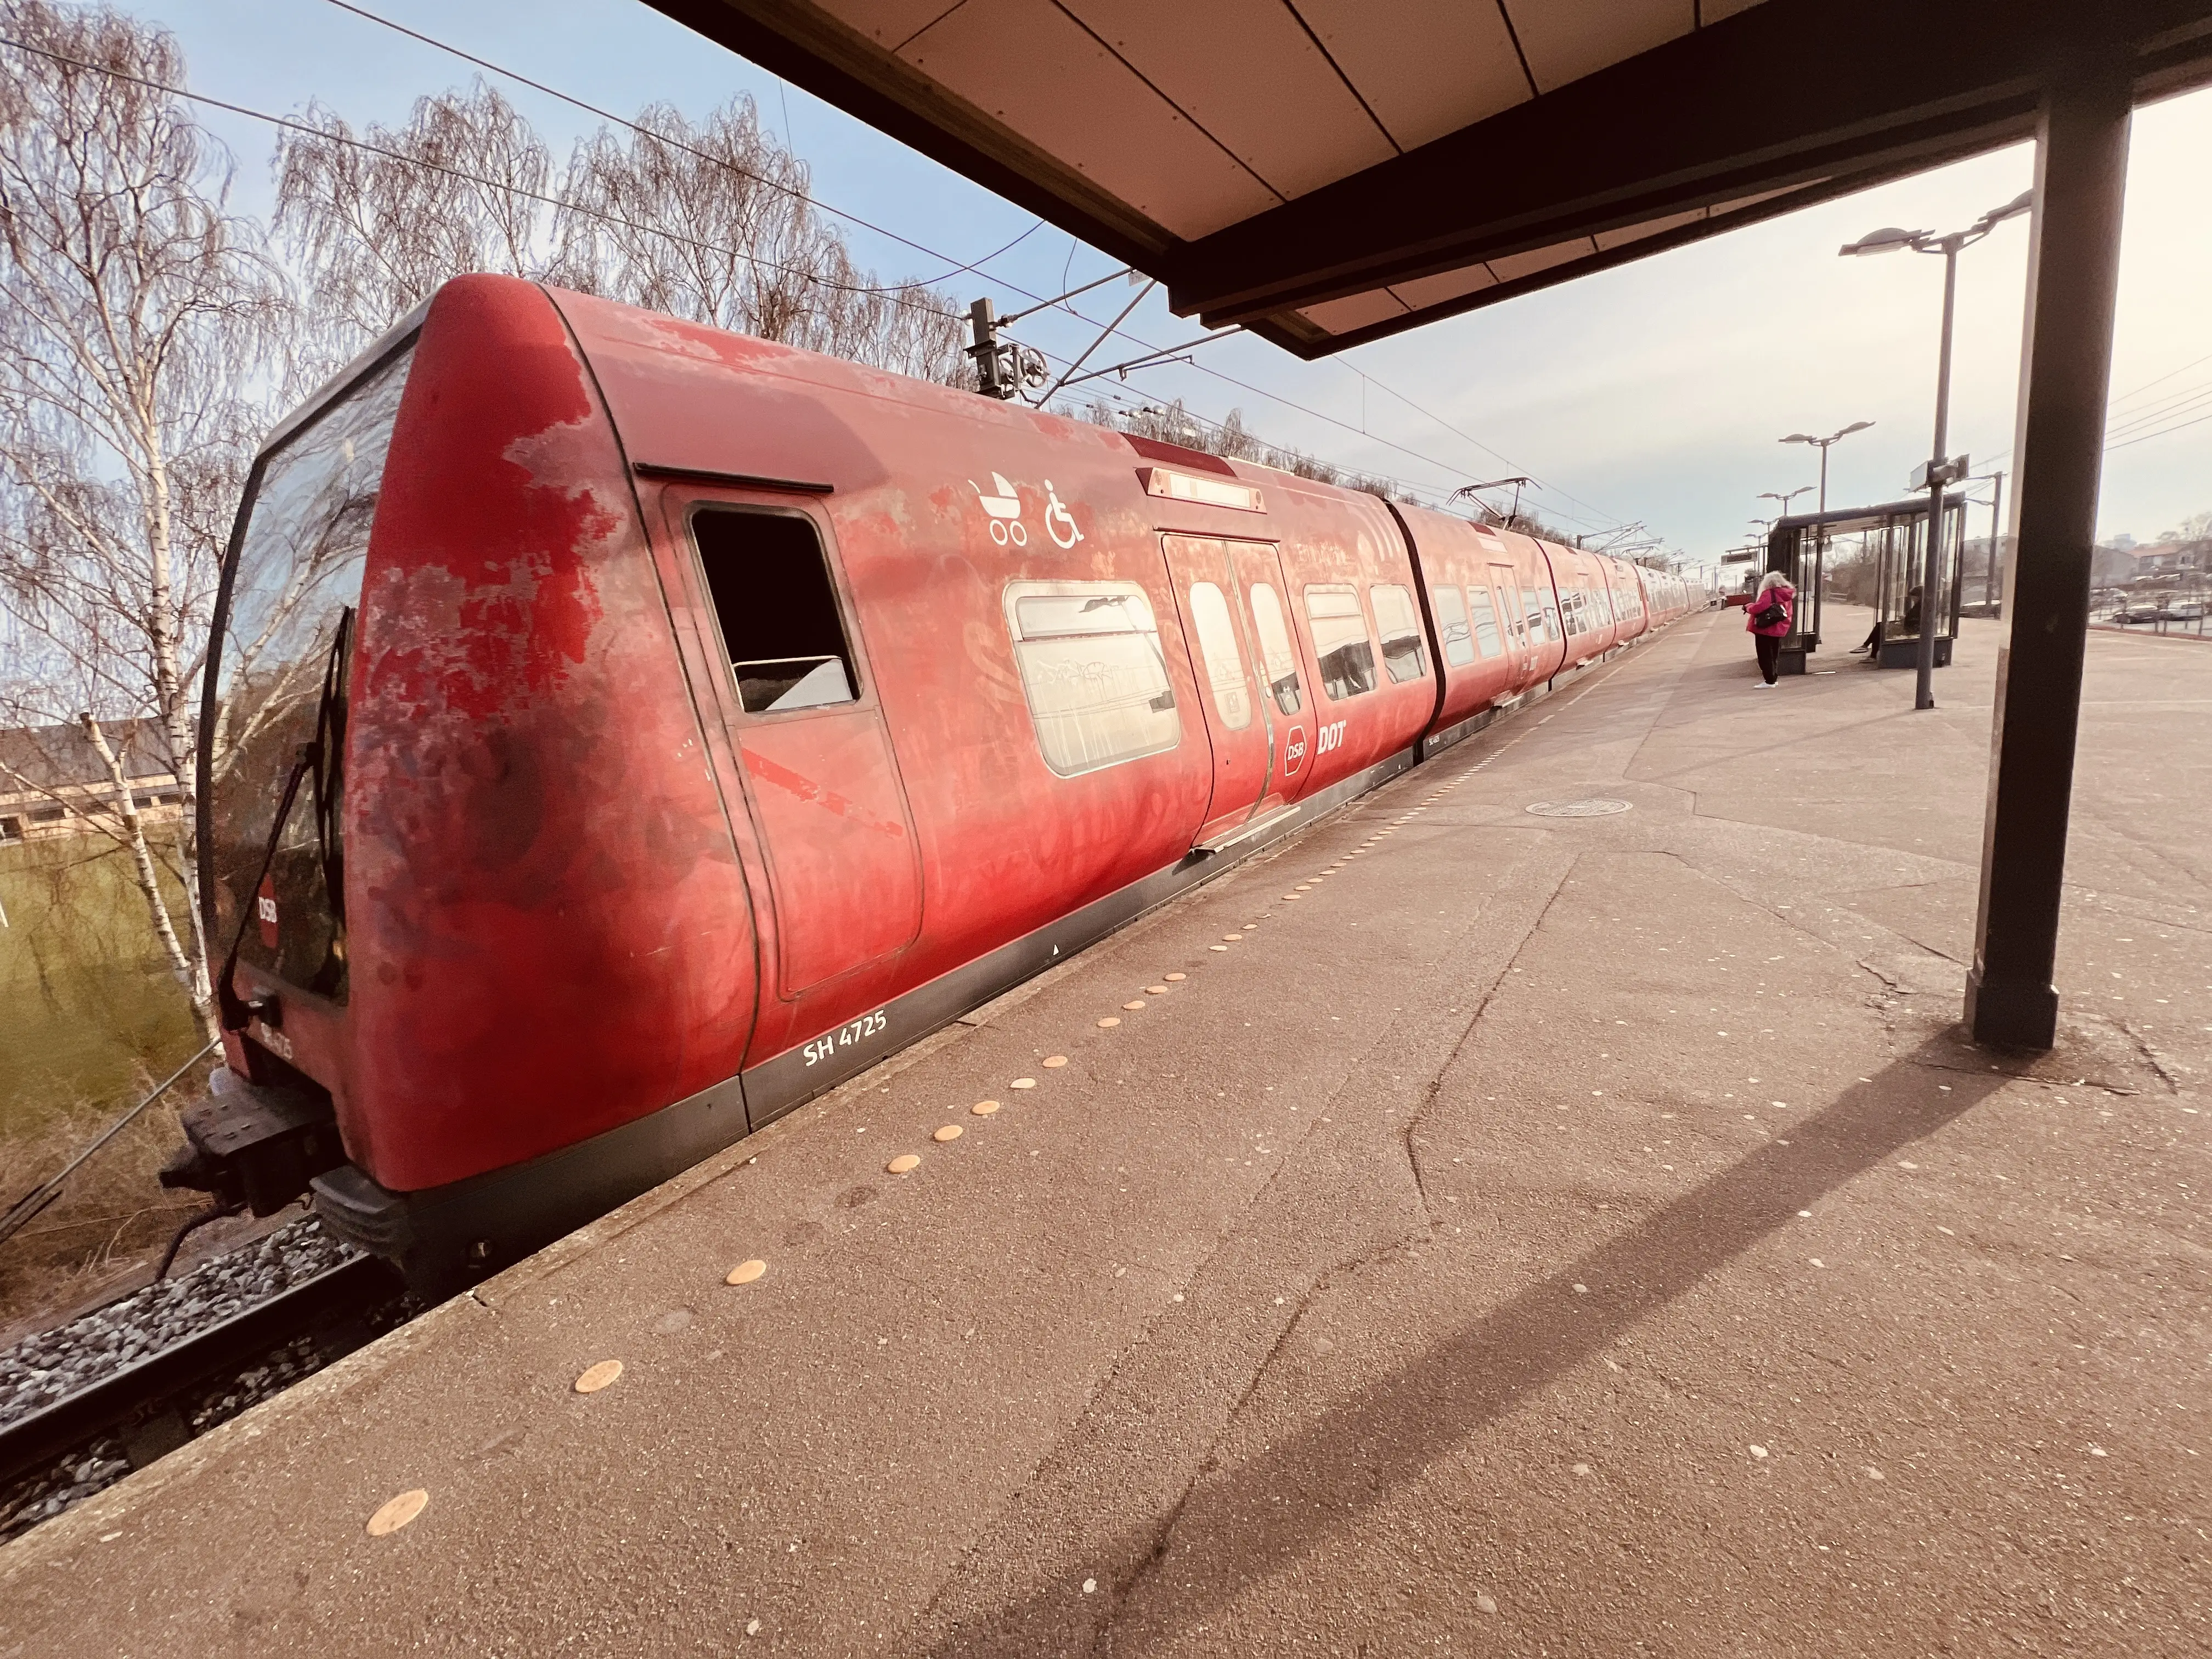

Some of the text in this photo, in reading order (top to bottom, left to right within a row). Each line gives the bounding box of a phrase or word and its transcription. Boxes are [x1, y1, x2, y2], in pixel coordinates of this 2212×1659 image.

[1287, 741, 1304, 761] DSB
[1317, 719, 1347, 755] DOT
[803, 1009, 887, 1066] SH 4725
